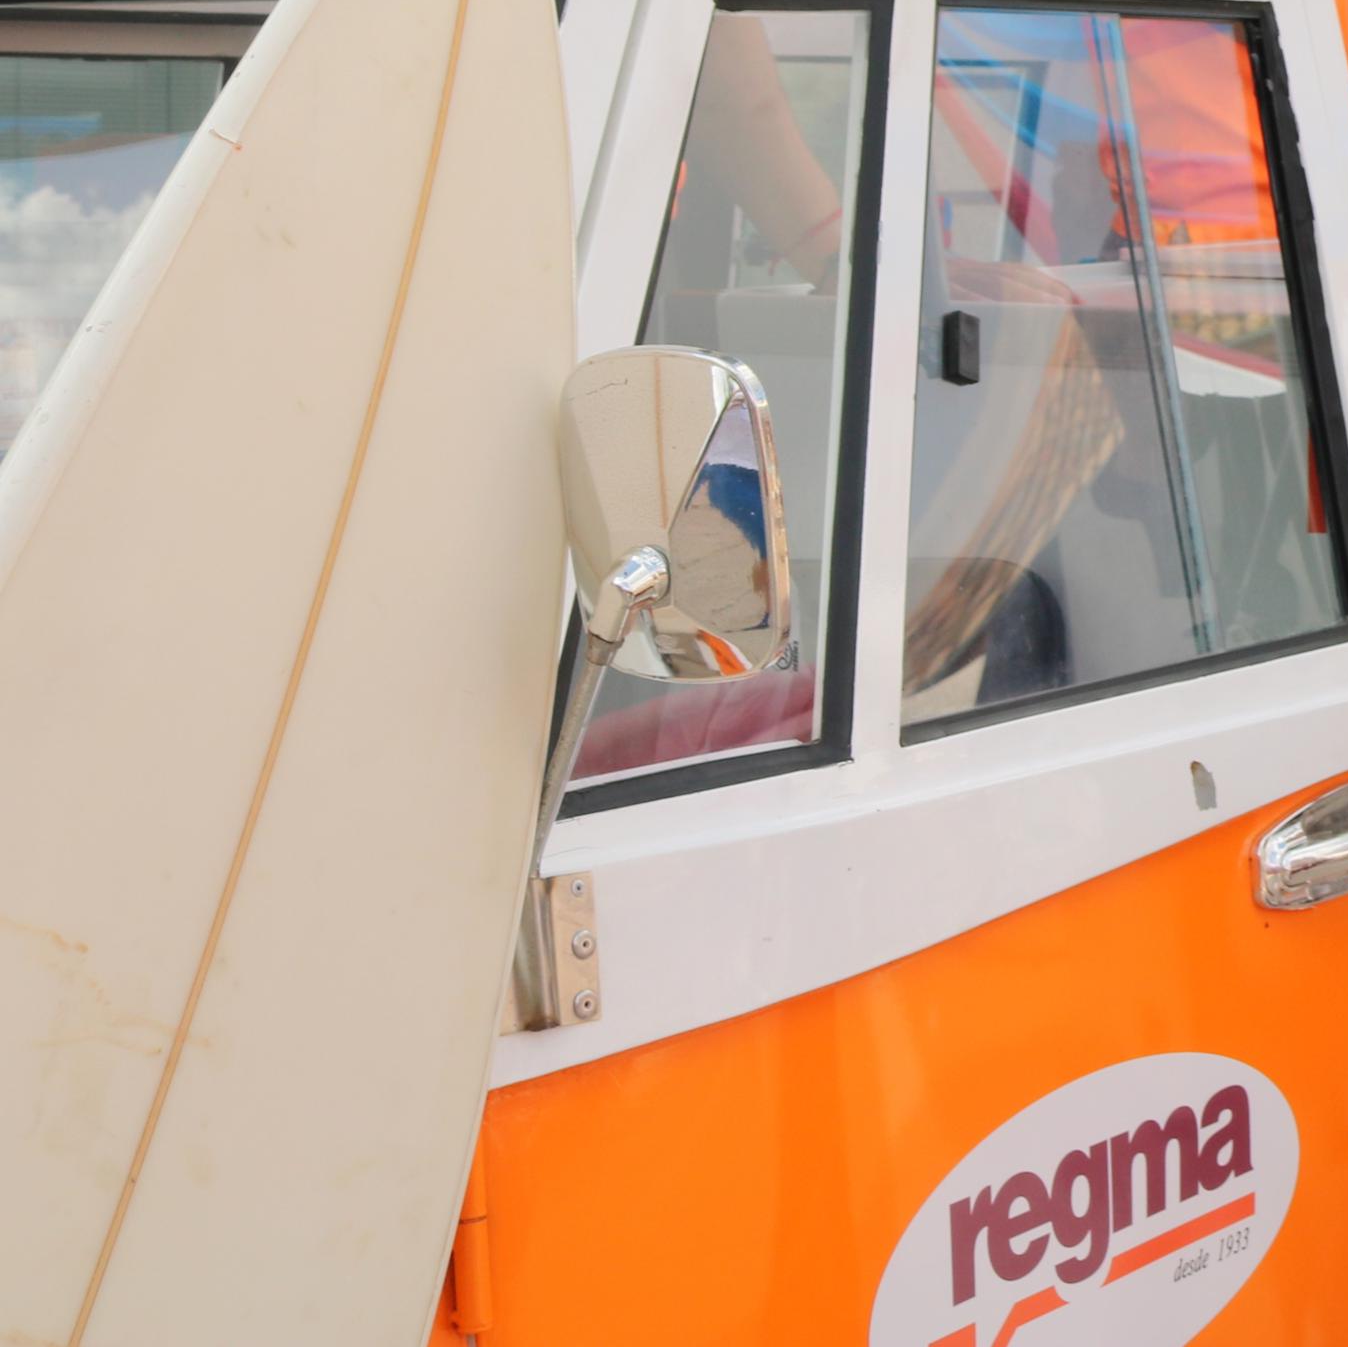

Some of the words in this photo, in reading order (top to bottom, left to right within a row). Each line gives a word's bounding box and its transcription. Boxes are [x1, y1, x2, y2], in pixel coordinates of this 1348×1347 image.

[949, 1084, 1255, 1307] regma
[1172, 1247, 1211, 1284] desde
[1216, 1226, 1251, 1265] 1933
